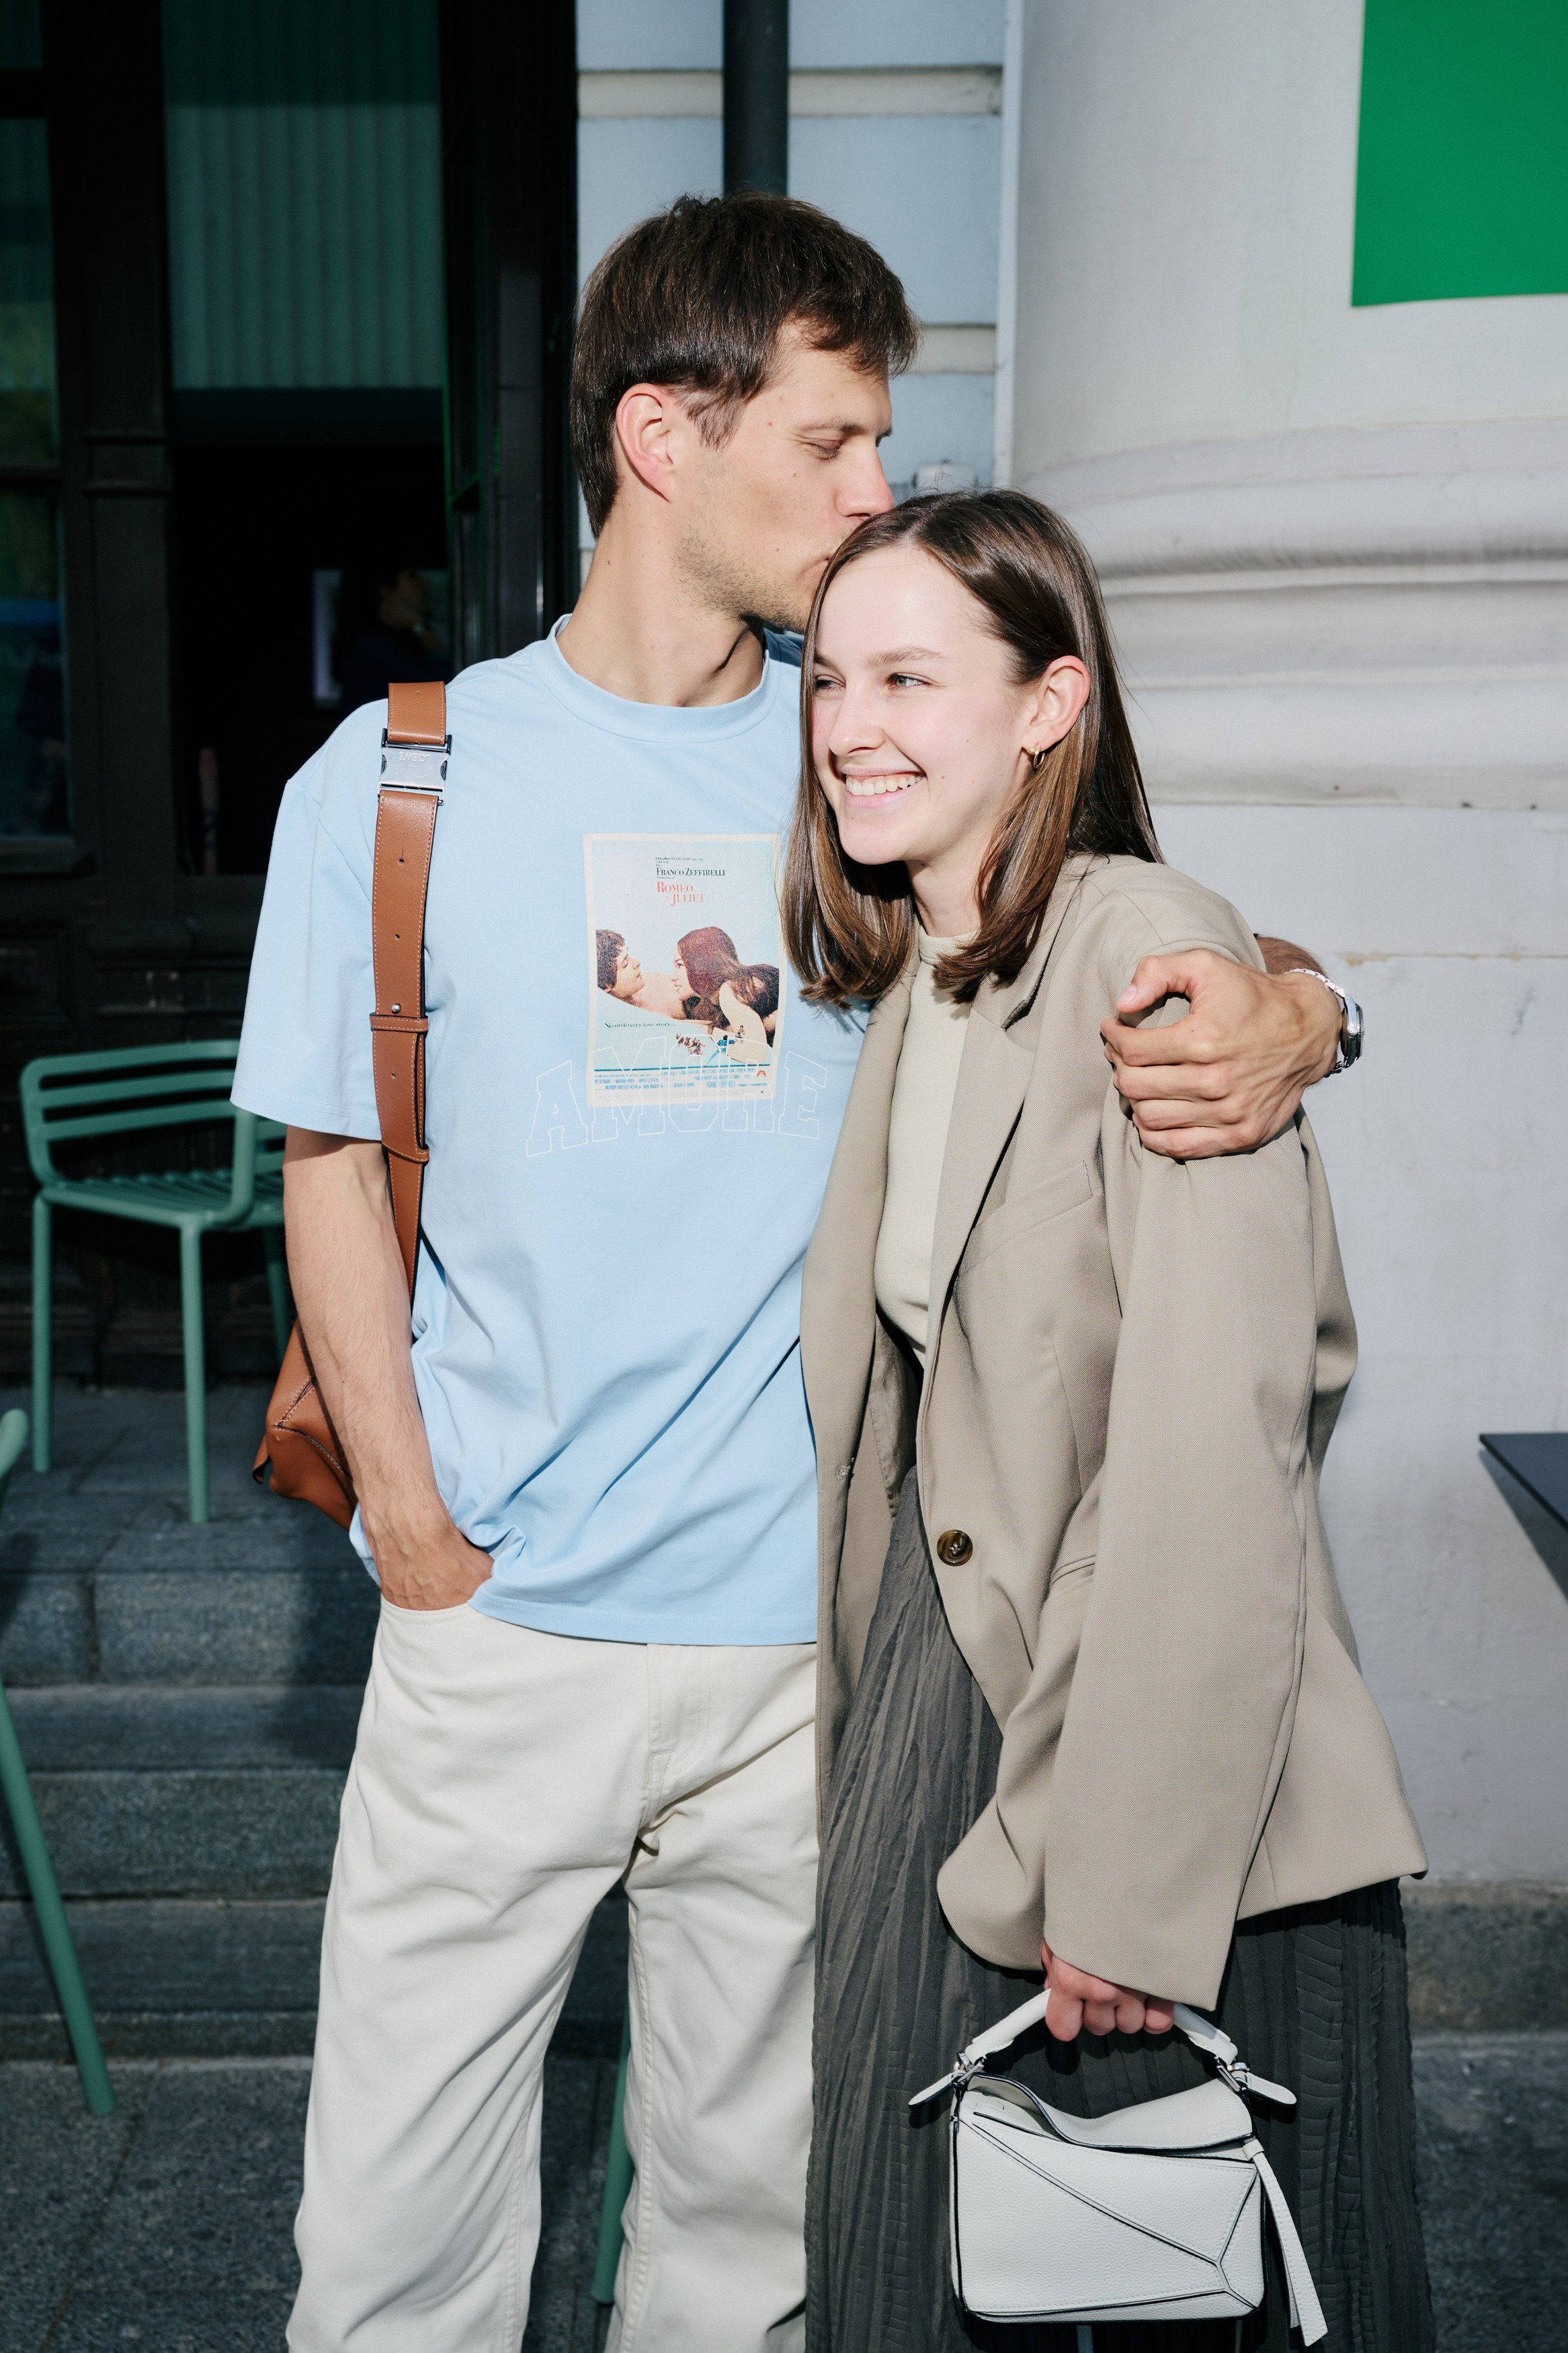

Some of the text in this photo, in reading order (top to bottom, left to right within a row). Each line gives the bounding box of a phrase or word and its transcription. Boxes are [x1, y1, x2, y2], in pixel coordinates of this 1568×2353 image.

[399, 752, 430, 762] LOEWE
[671, 893, 704, 906] JULIET
[526, 1034, 827, 1157] AMORE
